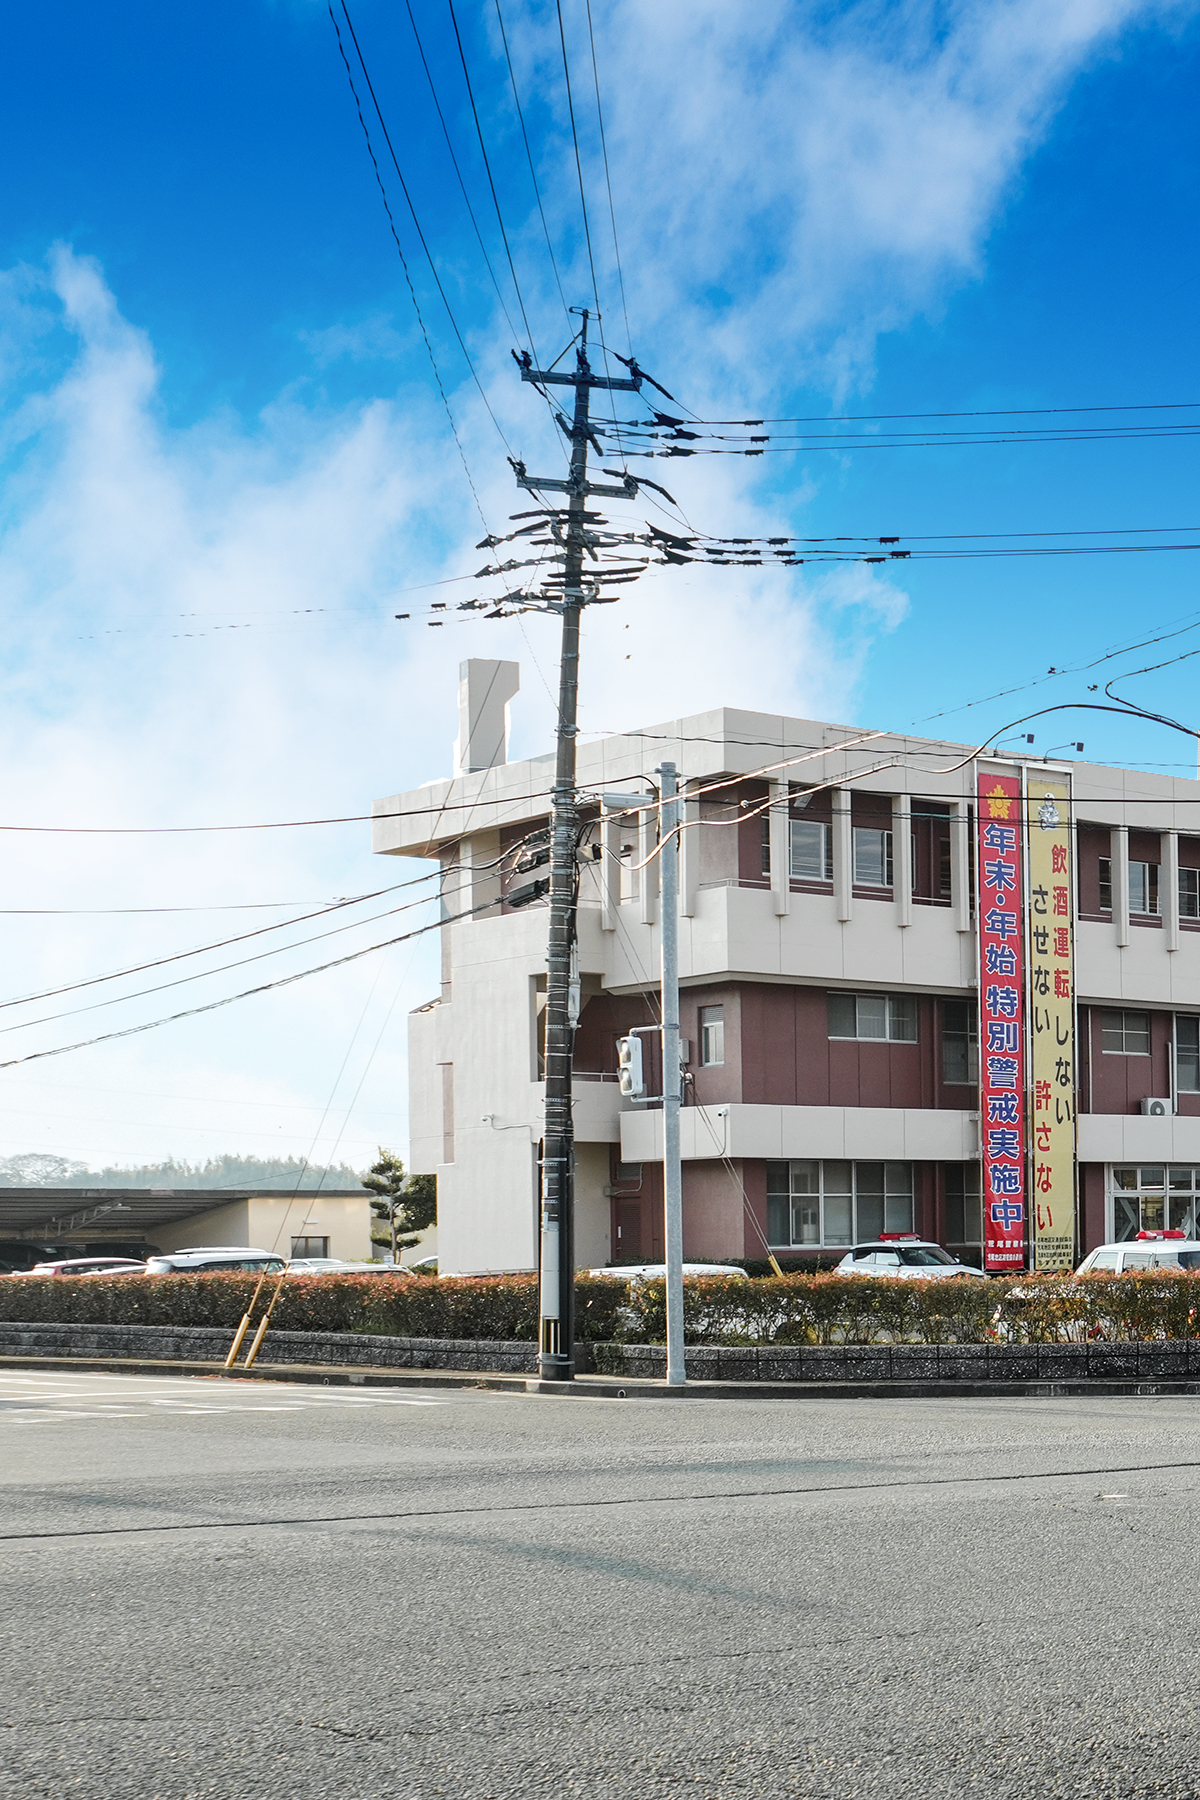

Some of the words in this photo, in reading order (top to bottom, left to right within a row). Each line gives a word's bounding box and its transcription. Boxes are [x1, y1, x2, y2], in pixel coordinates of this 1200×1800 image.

[1032, 884, 1051, 1034] させない
[1036, 1080, 1053, 1231] 許さない
